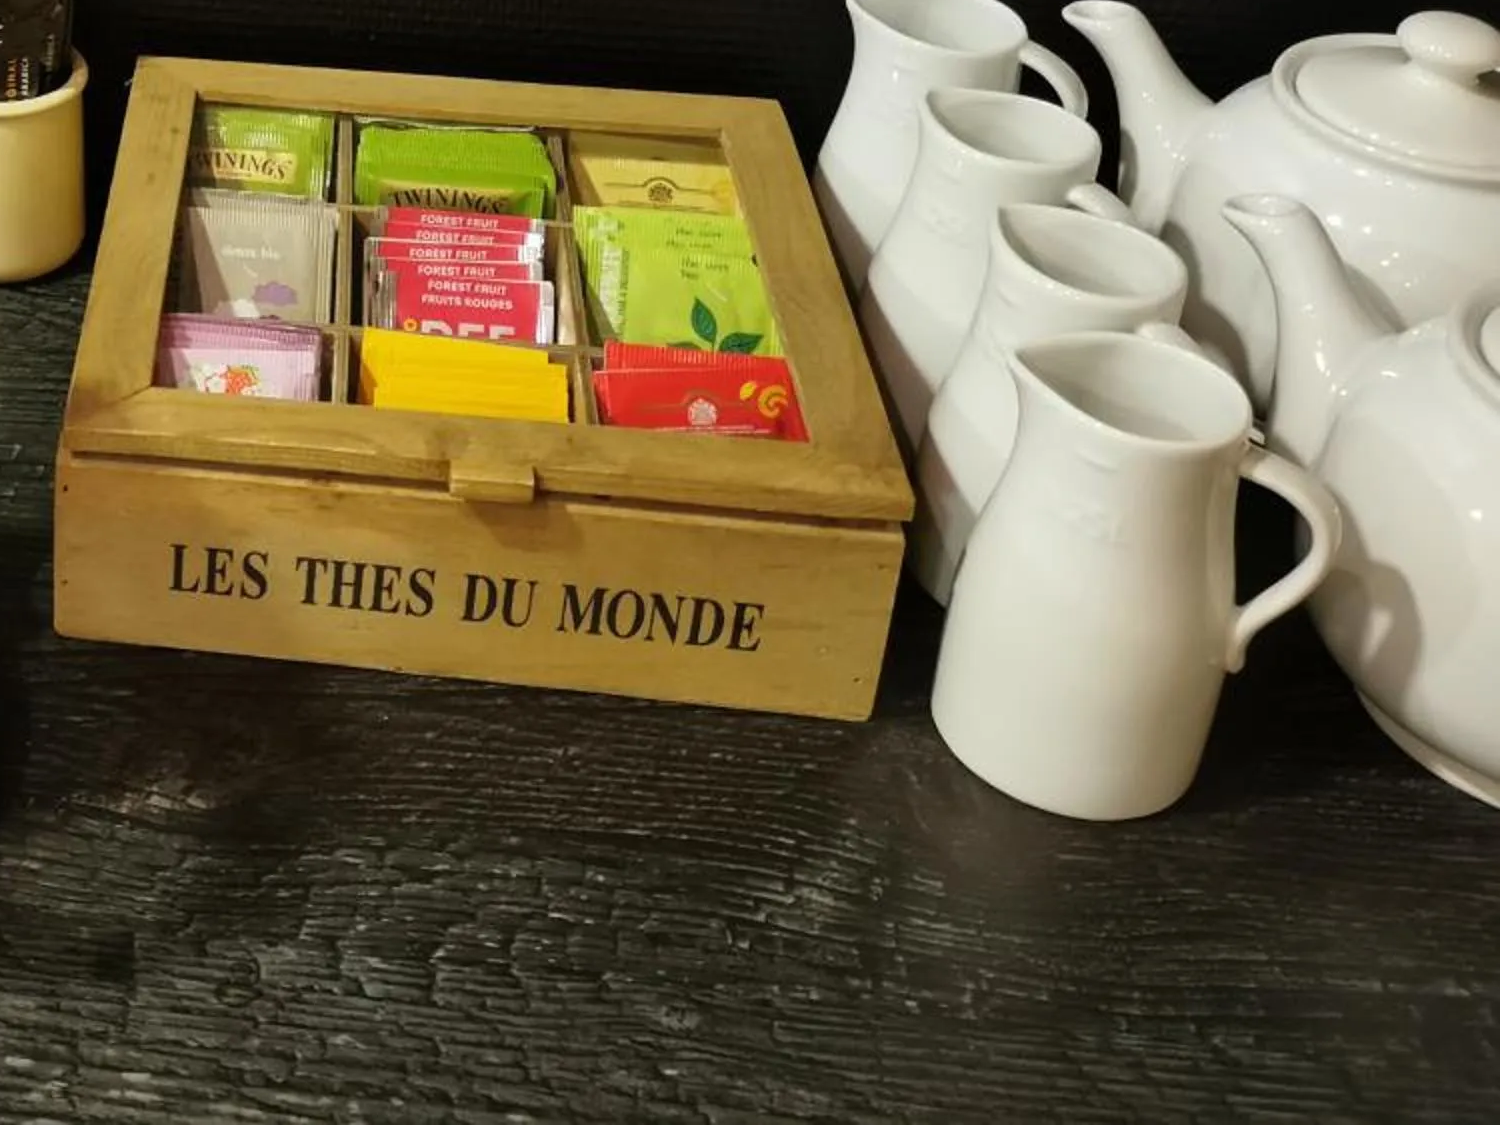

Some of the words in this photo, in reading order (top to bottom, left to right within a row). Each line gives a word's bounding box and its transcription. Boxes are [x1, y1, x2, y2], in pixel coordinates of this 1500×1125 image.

[194, 150, 290, 181] WININGS
[420, 214, 463, 226] FOREST
[466, 218, 499, 229] FRUIT
[409, 248, 452, 259] FOREST
[455, 250, 488, 260] FRUIT
[417, 264, 461, 275] FOREST
[463, 266, 496, 277] FRUIT
[427, 280, 473, 293] FOREST
[474, 283, 507, 296] FRUIT
[421, 294, 462, 307] FRUITS
[464, 297, 513, 310] ROUGES
[168, 543, 269, 600] LES
[295, 556, 436, 617] THES
[461, 573, 539, 627] DU
[556, 583, 765, 652] MONDE
